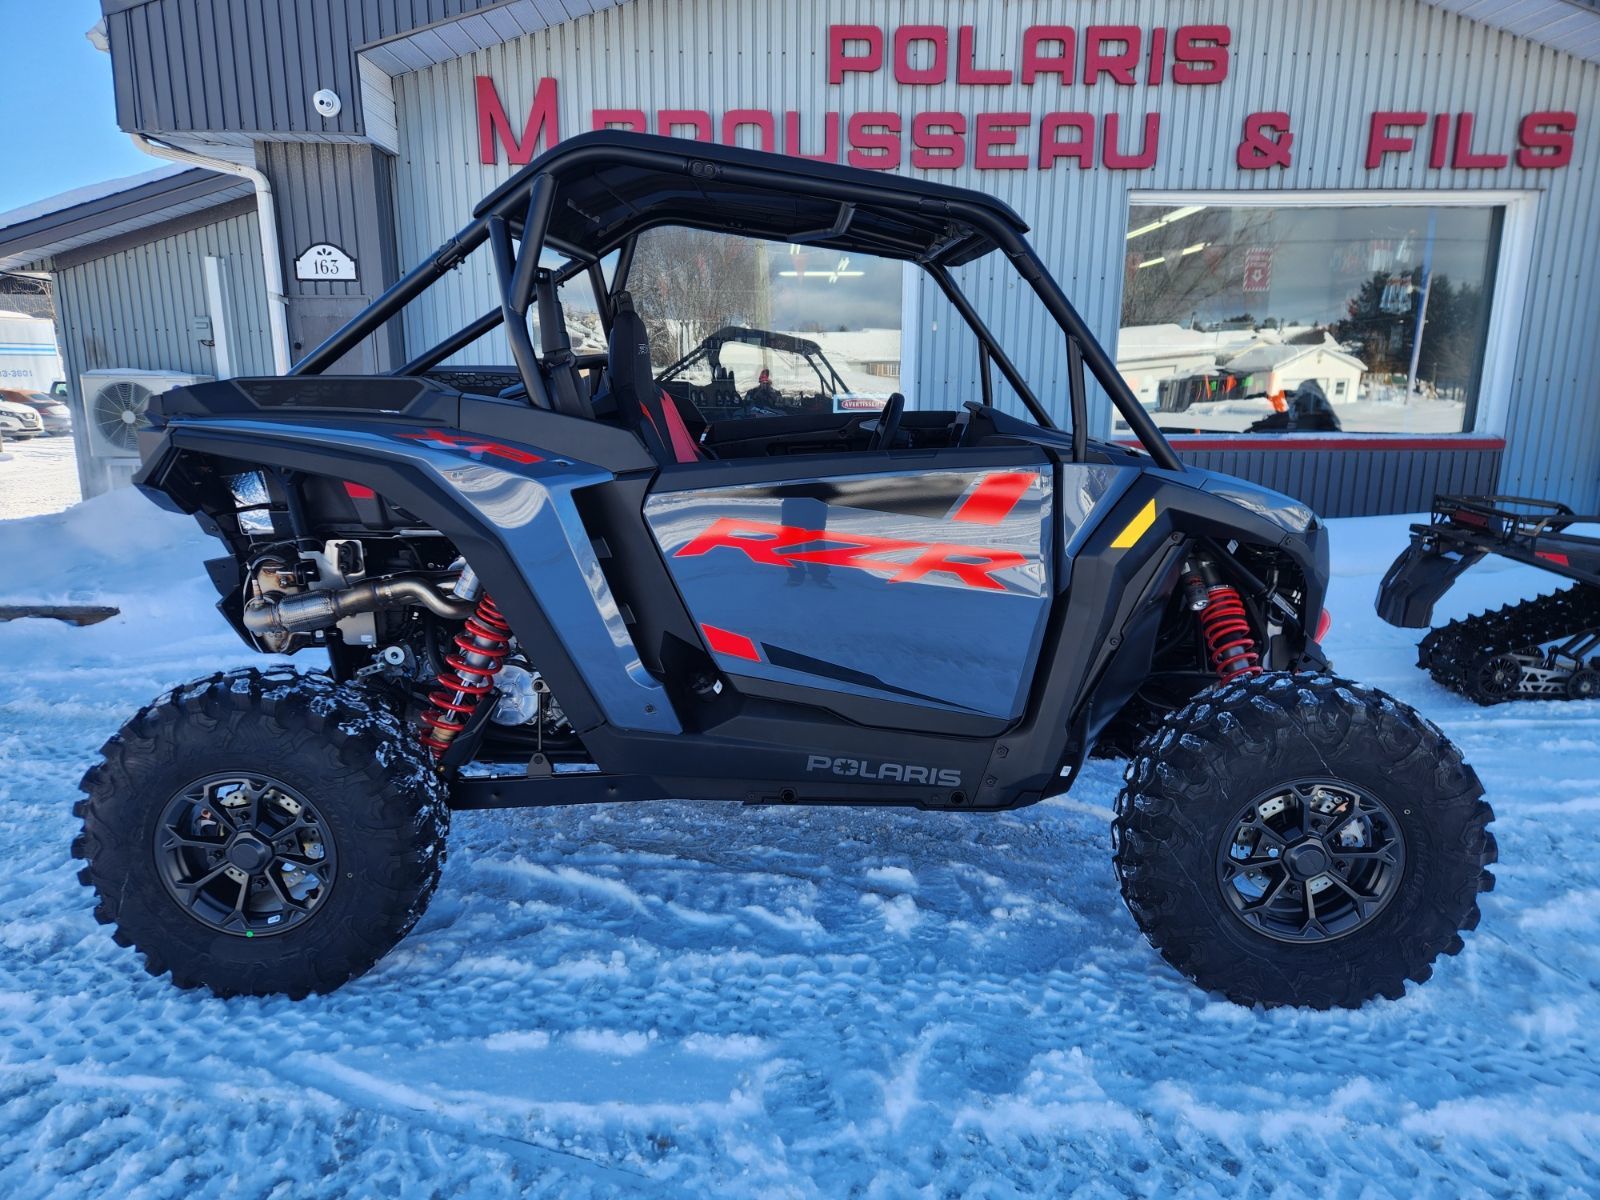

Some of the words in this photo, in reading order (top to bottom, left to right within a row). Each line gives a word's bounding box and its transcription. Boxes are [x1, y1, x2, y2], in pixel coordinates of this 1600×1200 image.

[828, 25, 1231, 87] POLARIS
[1237, 111, 1294, 170] &
[1366, 111, 1577, 170] FILS
[314, 259, 339, 275] 163
[672, 517, 1029, 591] RZR
[806, 754, 962, 787] POLARIS
